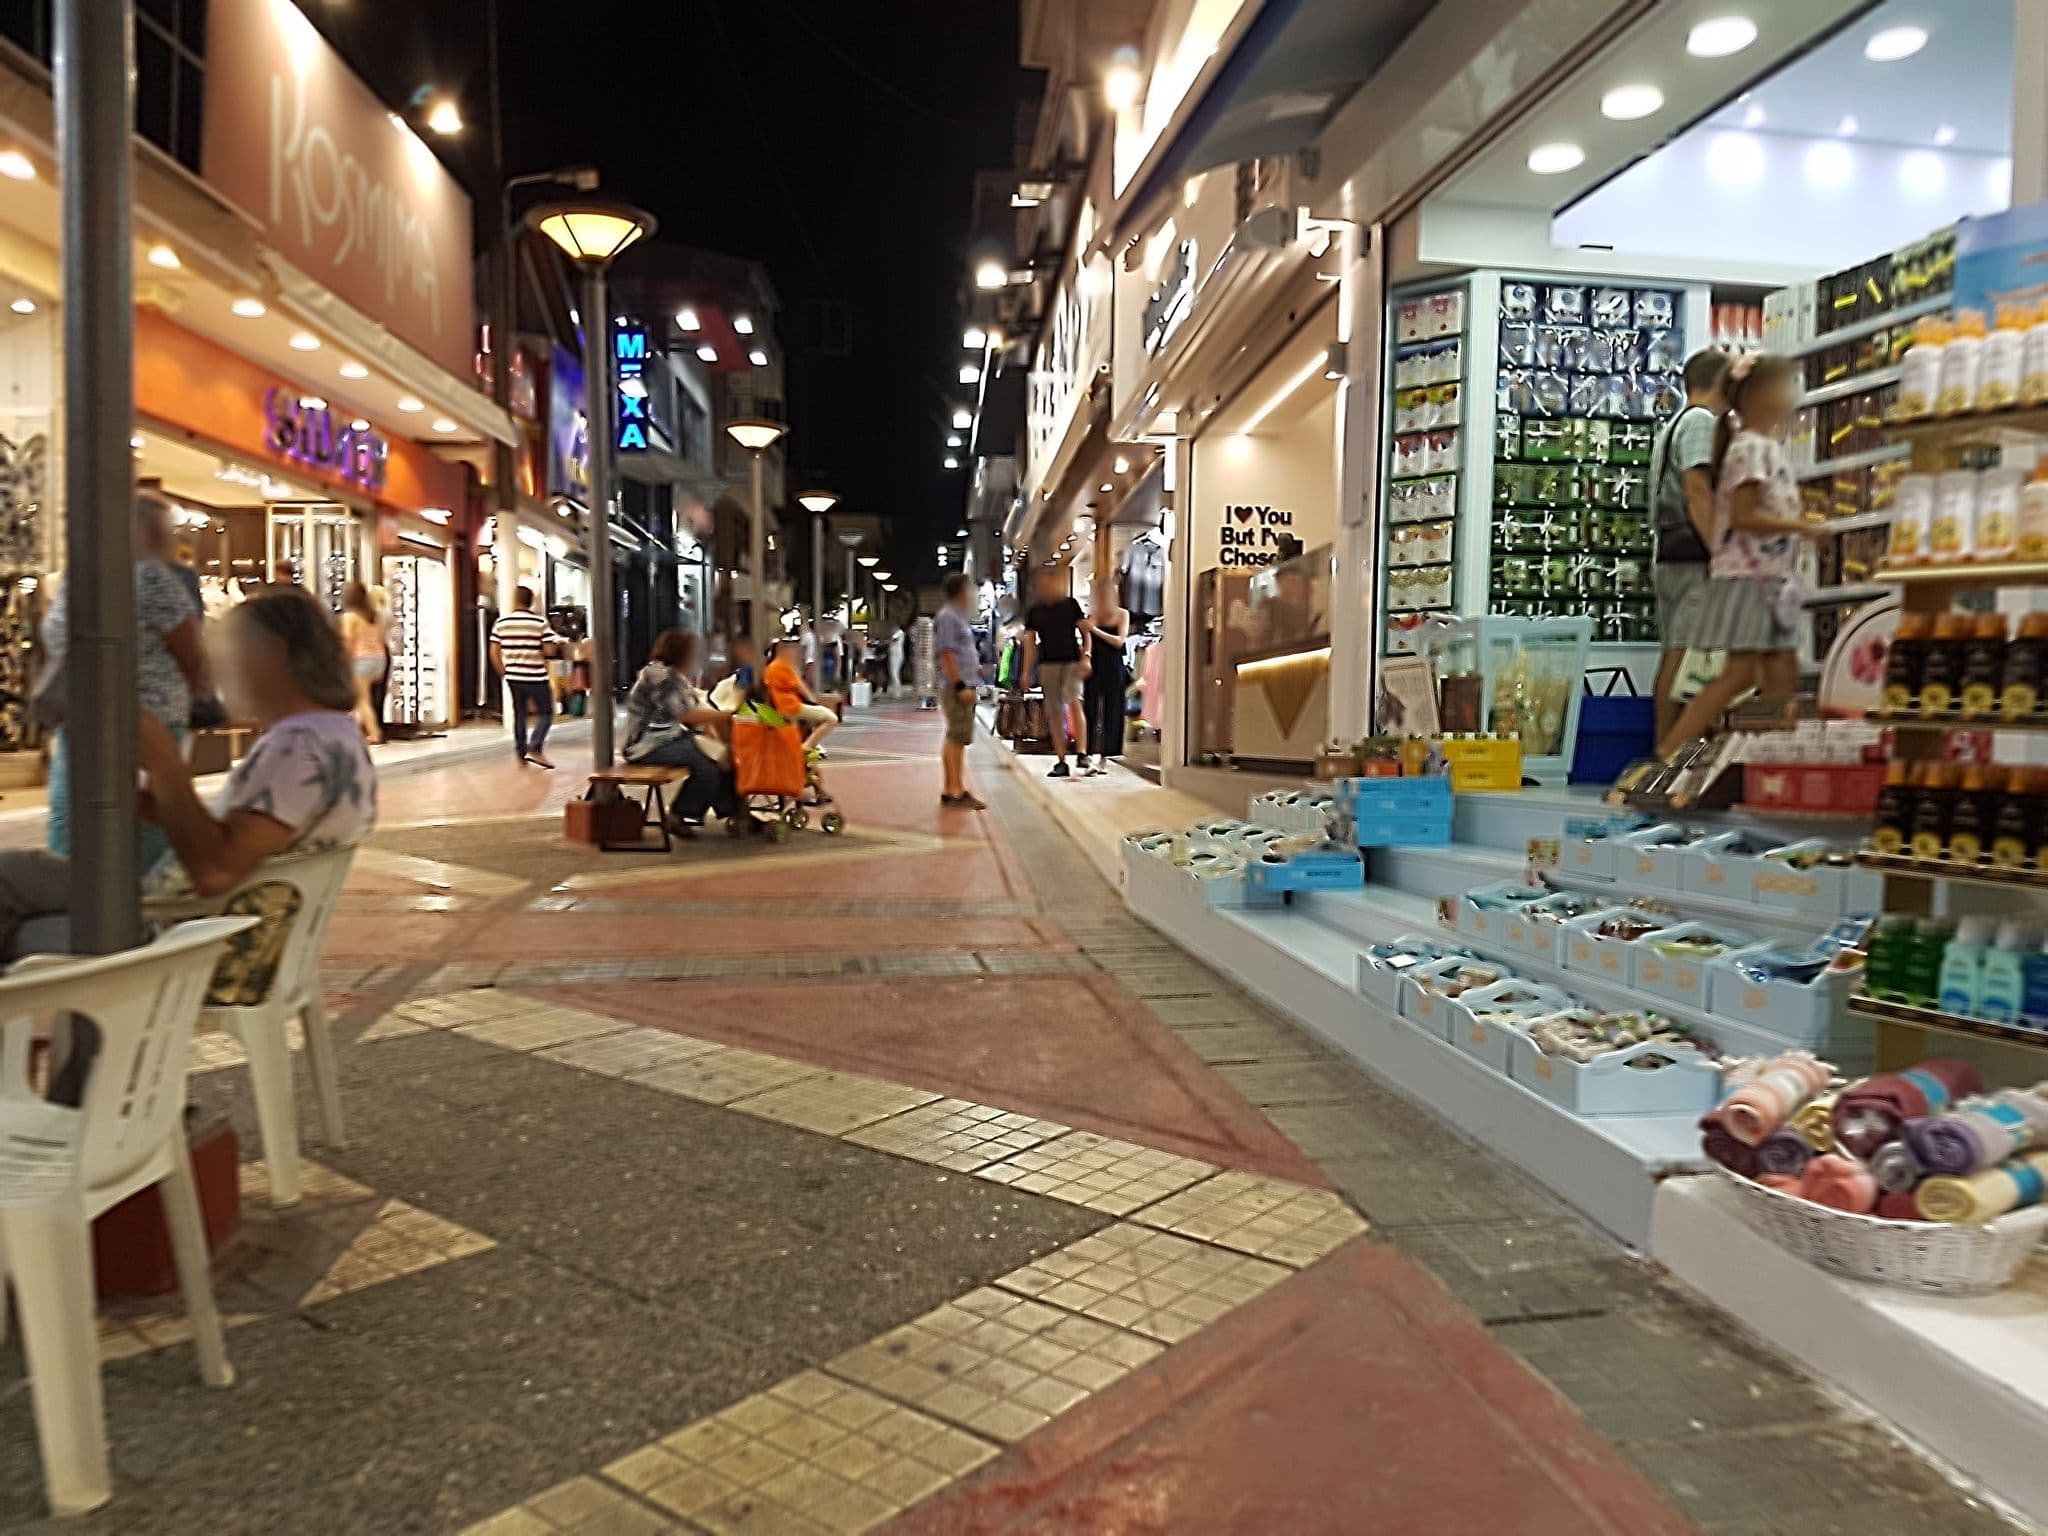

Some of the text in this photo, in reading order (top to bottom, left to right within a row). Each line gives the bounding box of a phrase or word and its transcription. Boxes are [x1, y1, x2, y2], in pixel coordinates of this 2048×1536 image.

[1225, 505, 1292, 526] I You
[1221, 526, 1255, 546] But
